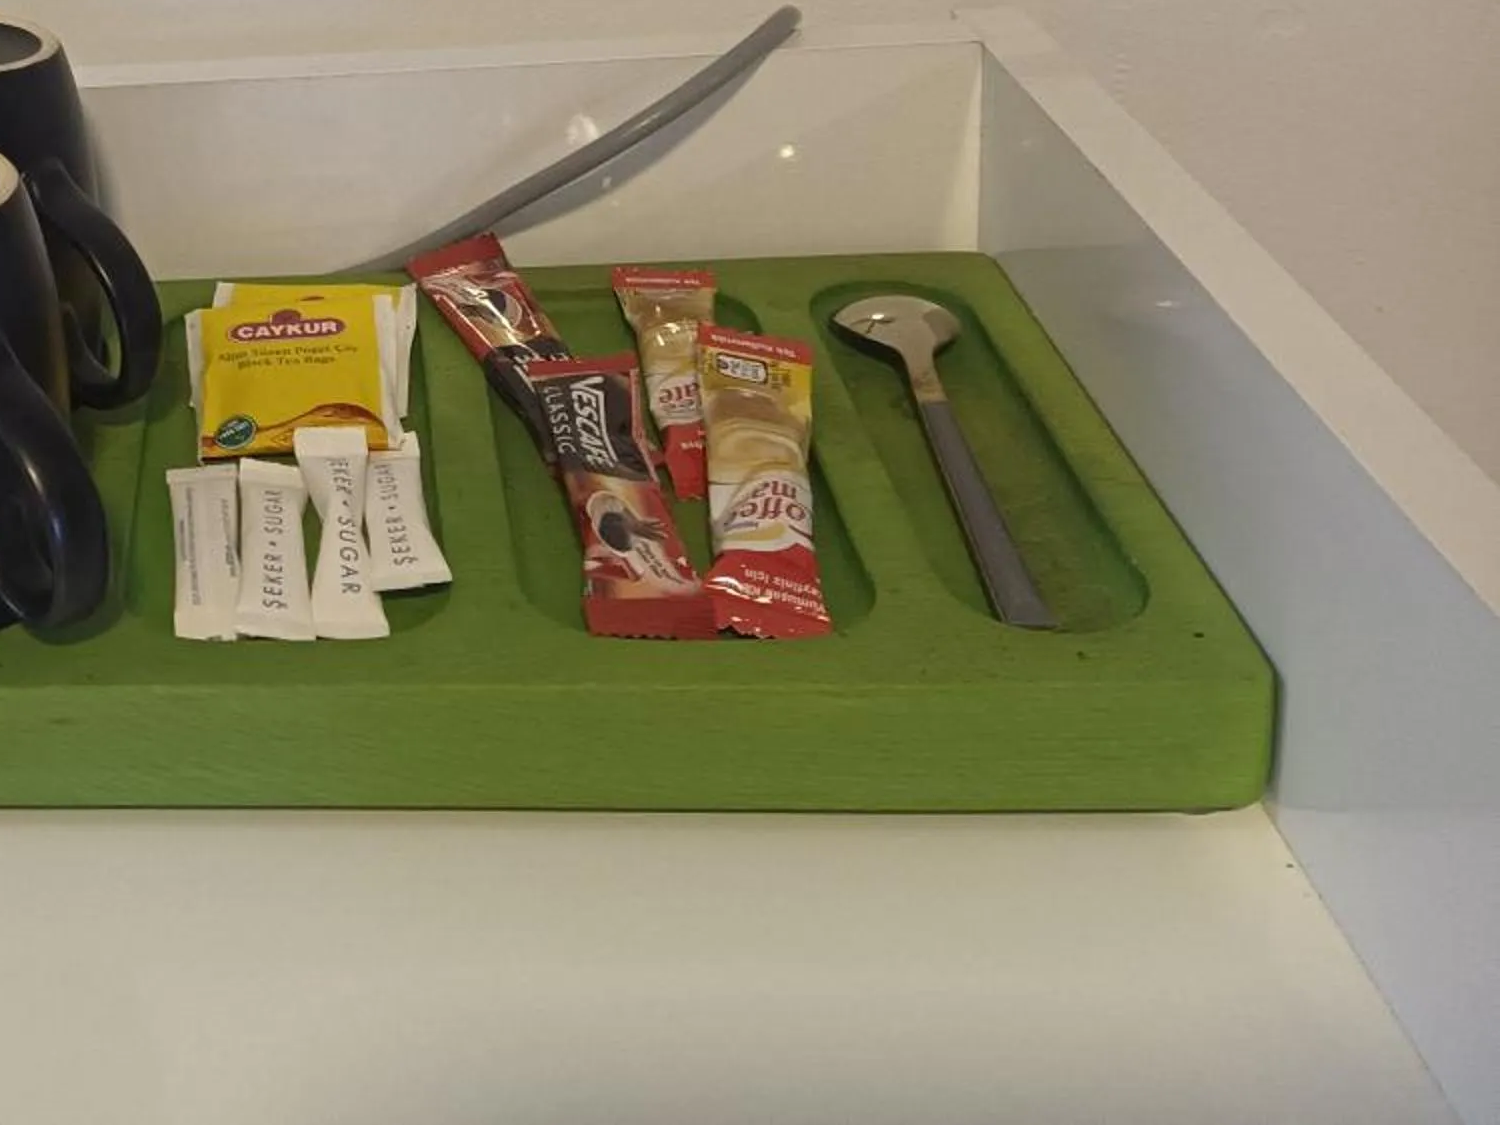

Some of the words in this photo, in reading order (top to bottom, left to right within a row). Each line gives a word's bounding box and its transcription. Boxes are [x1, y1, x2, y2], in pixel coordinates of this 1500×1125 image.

[543, 386, 577, 454] CLASSIC
[263, 489, 284, 535] SUGAR
[337, 515, 362, 594] SUGAR
